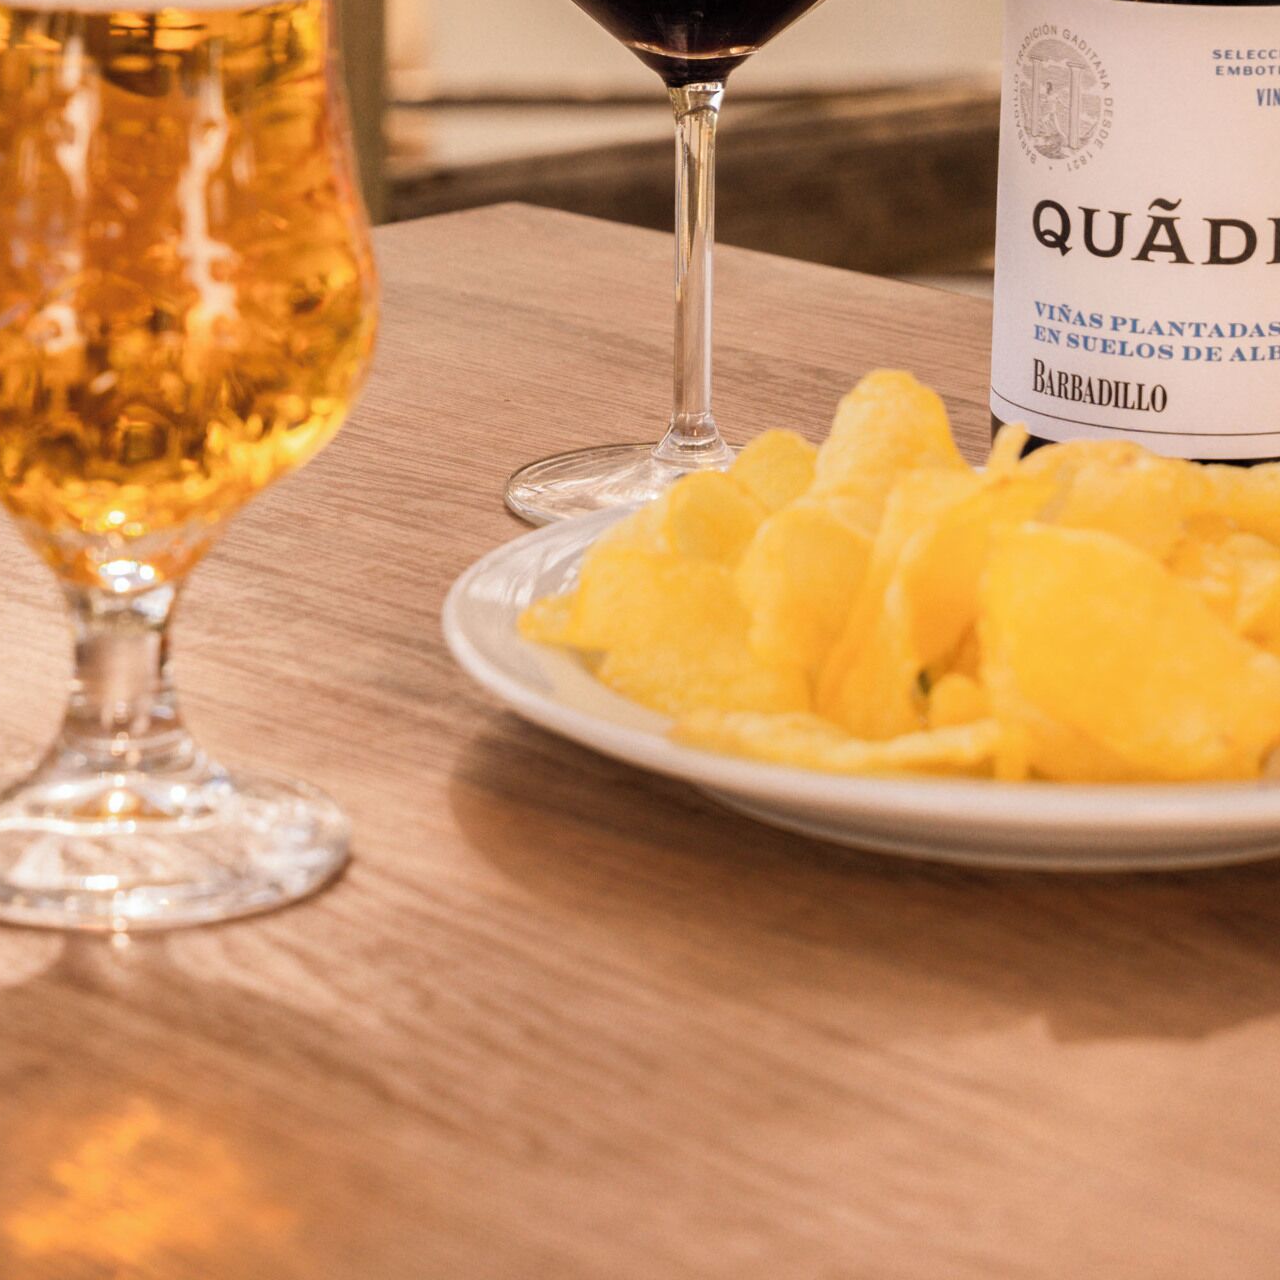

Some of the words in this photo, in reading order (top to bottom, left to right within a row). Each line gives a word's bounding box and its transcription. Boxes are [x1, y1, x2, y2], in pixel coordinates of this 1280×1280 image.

[1016, 23, 1058, 66] TRADICIÓN
[1062, 28, 1111, 90] GADITANA
[1094, 97, 1114, 150] DESDE
[1034, 301, 1104, 329] VIÑAS
[1034, 325, 1061, 346] EN
[1066, 334, 1174, 361] SUELOS
[1182, 346, 1223, 362] DE
[1032, 358, 1168, 413] BARBADILLO
